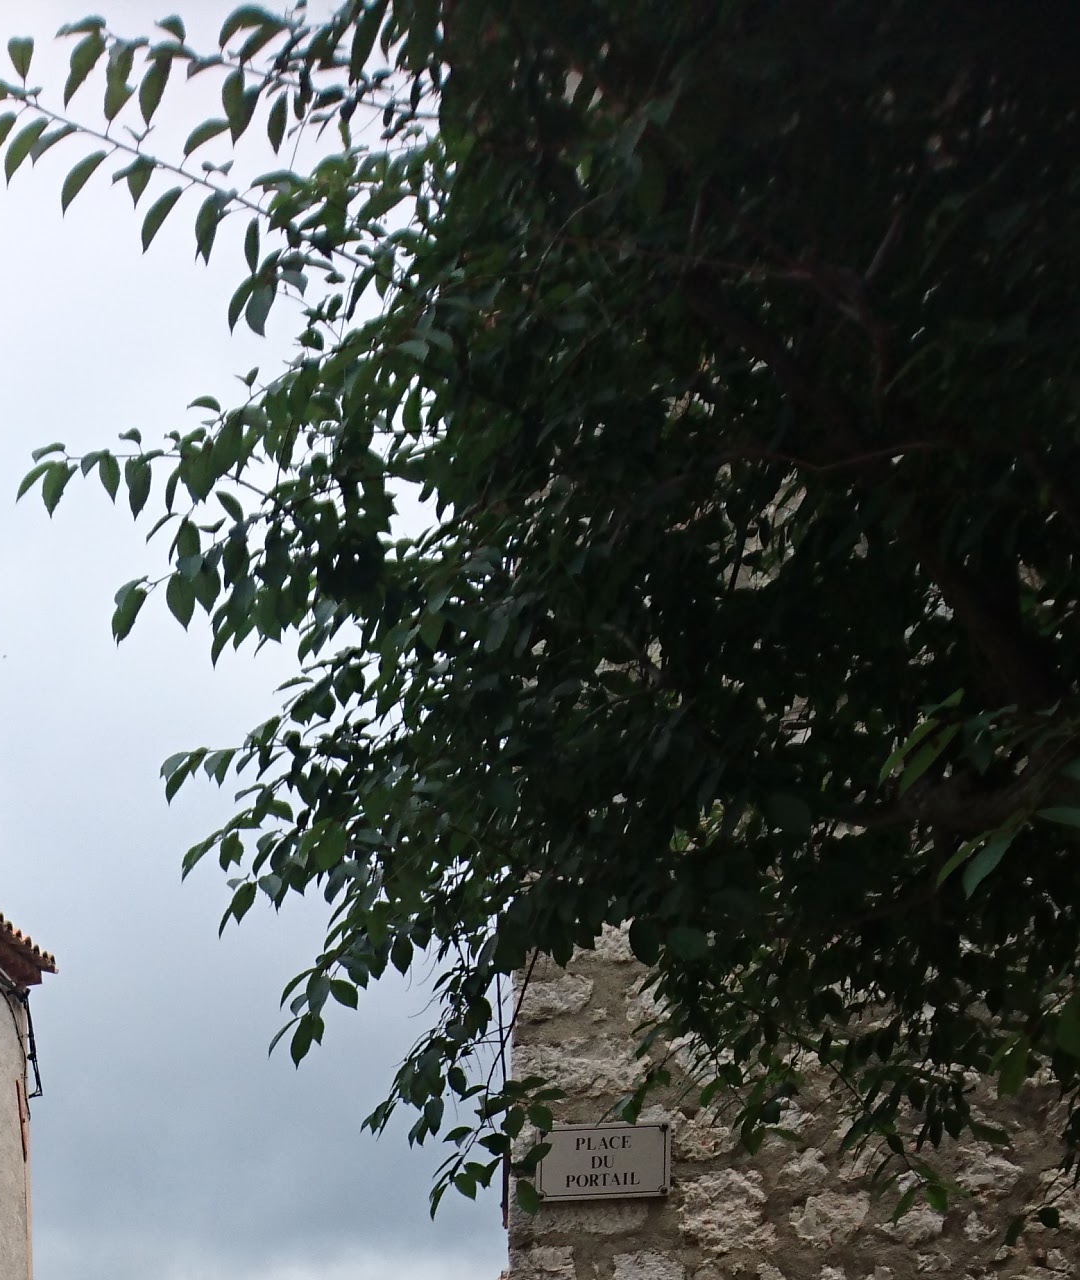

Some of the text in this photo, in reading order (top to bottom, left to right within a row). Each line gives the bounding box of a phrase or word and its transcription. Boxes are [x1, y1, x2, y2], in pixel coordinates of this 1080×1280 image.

[575, 1135, 632, 1151] PLACE
[591, 1155, 615, 1169] DU
[565, 1172, 640, 1188] PORTAIL
